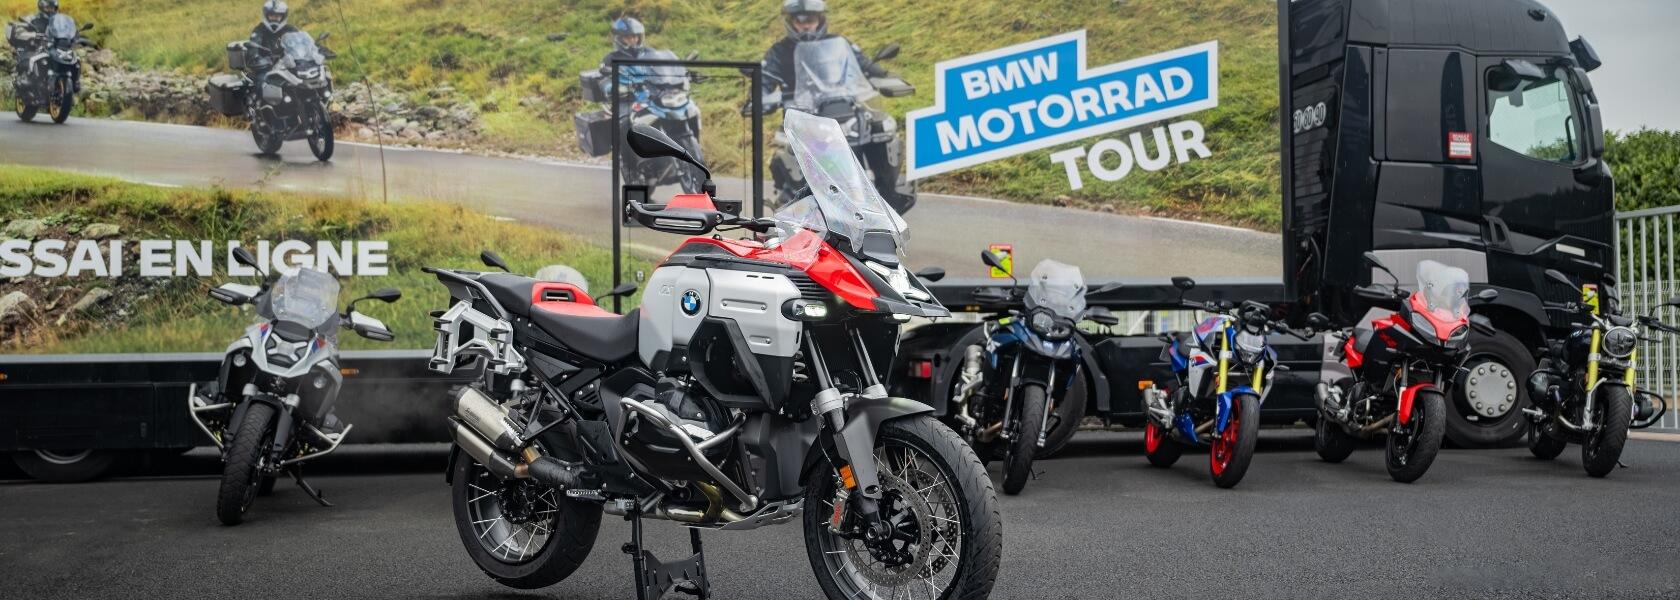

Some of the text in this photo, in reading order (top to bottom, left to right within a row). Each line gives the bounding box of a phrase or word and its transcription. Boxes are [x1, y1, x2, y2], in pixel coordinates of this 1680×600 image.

[960, 51, 1058, 100] BMW
[935, 66, 1194, 155] MOTORRAD
[1050, 119, 1212, 191] TOUR
[0, 239, 389, 277] SSAI EN LIGNE
